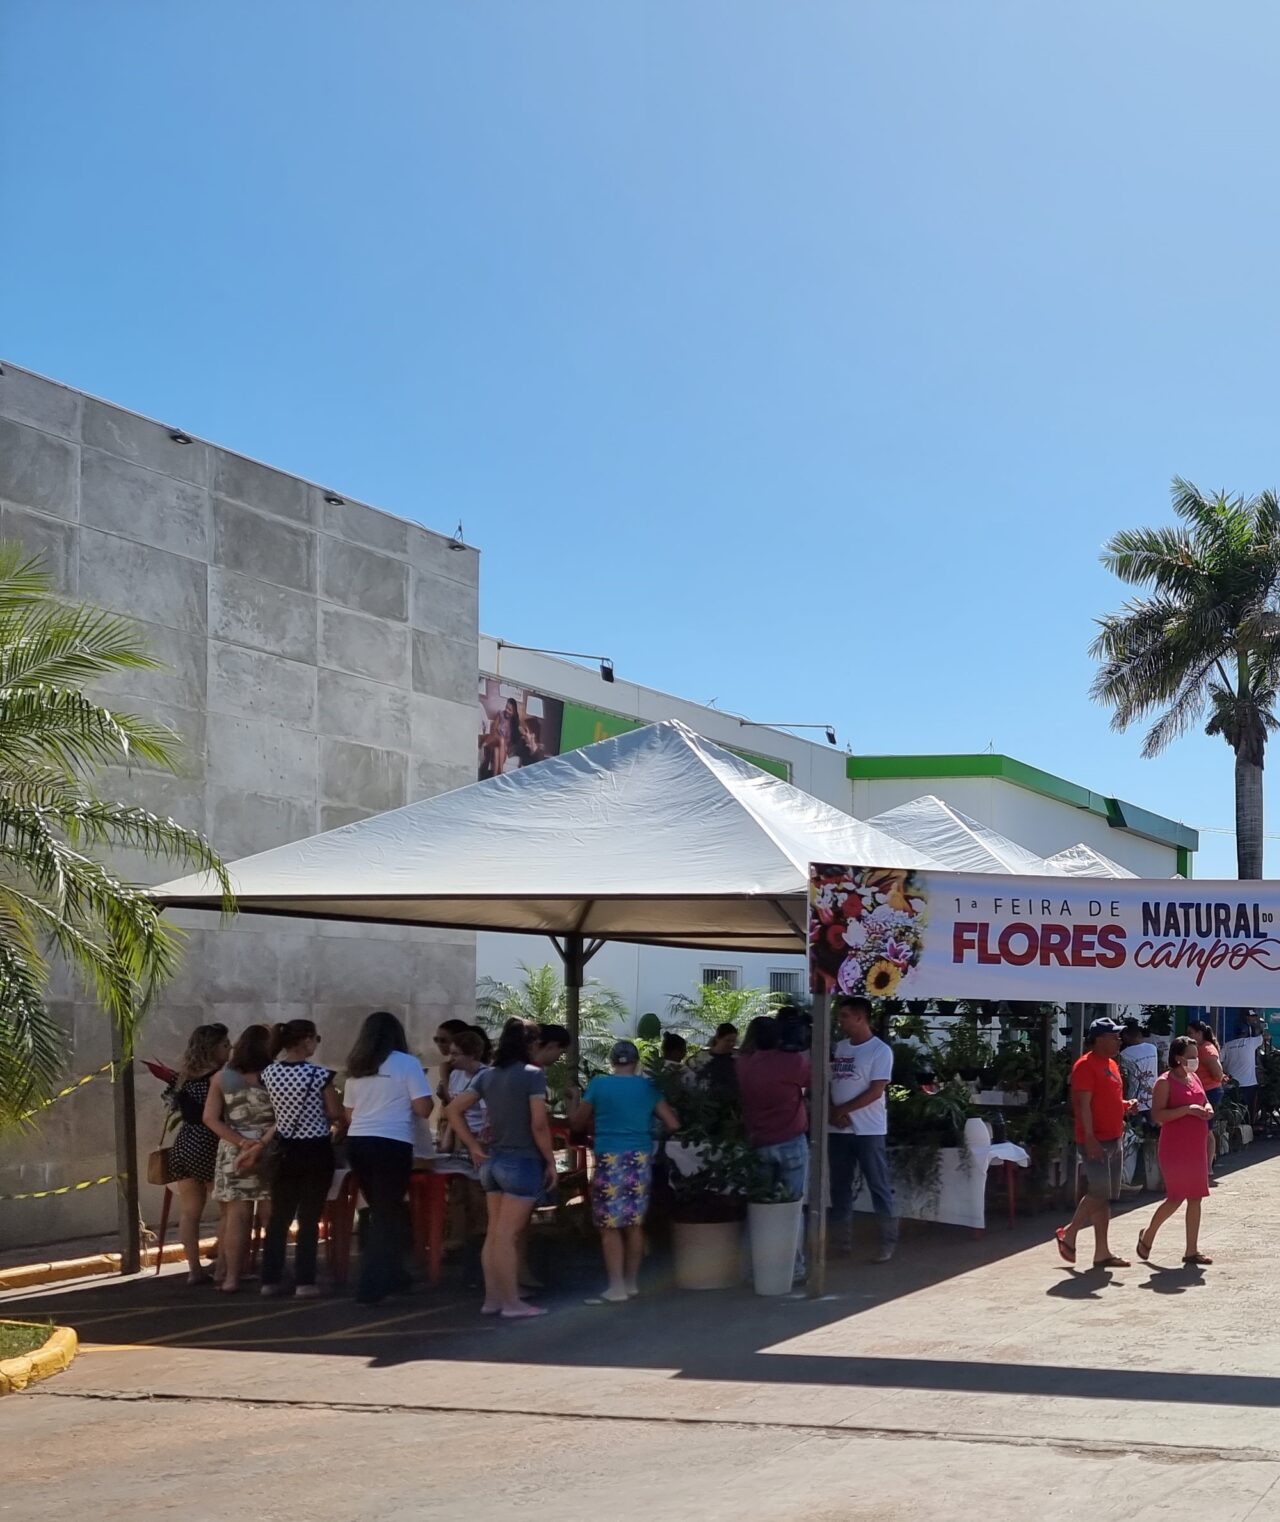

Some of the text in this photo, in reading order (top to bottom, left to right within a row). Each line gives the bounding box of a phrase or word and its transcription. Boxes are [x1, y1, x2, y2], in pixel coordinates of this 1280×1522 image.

[994, 898, 1072, 917] FEIRA
[1089, 900, 1120, 917] DE
[1141, 901, 1274, 939] NATURAL DO
[952, 921, 1127, 969] FLORES
[1133, 938, 1251, 987] campo
